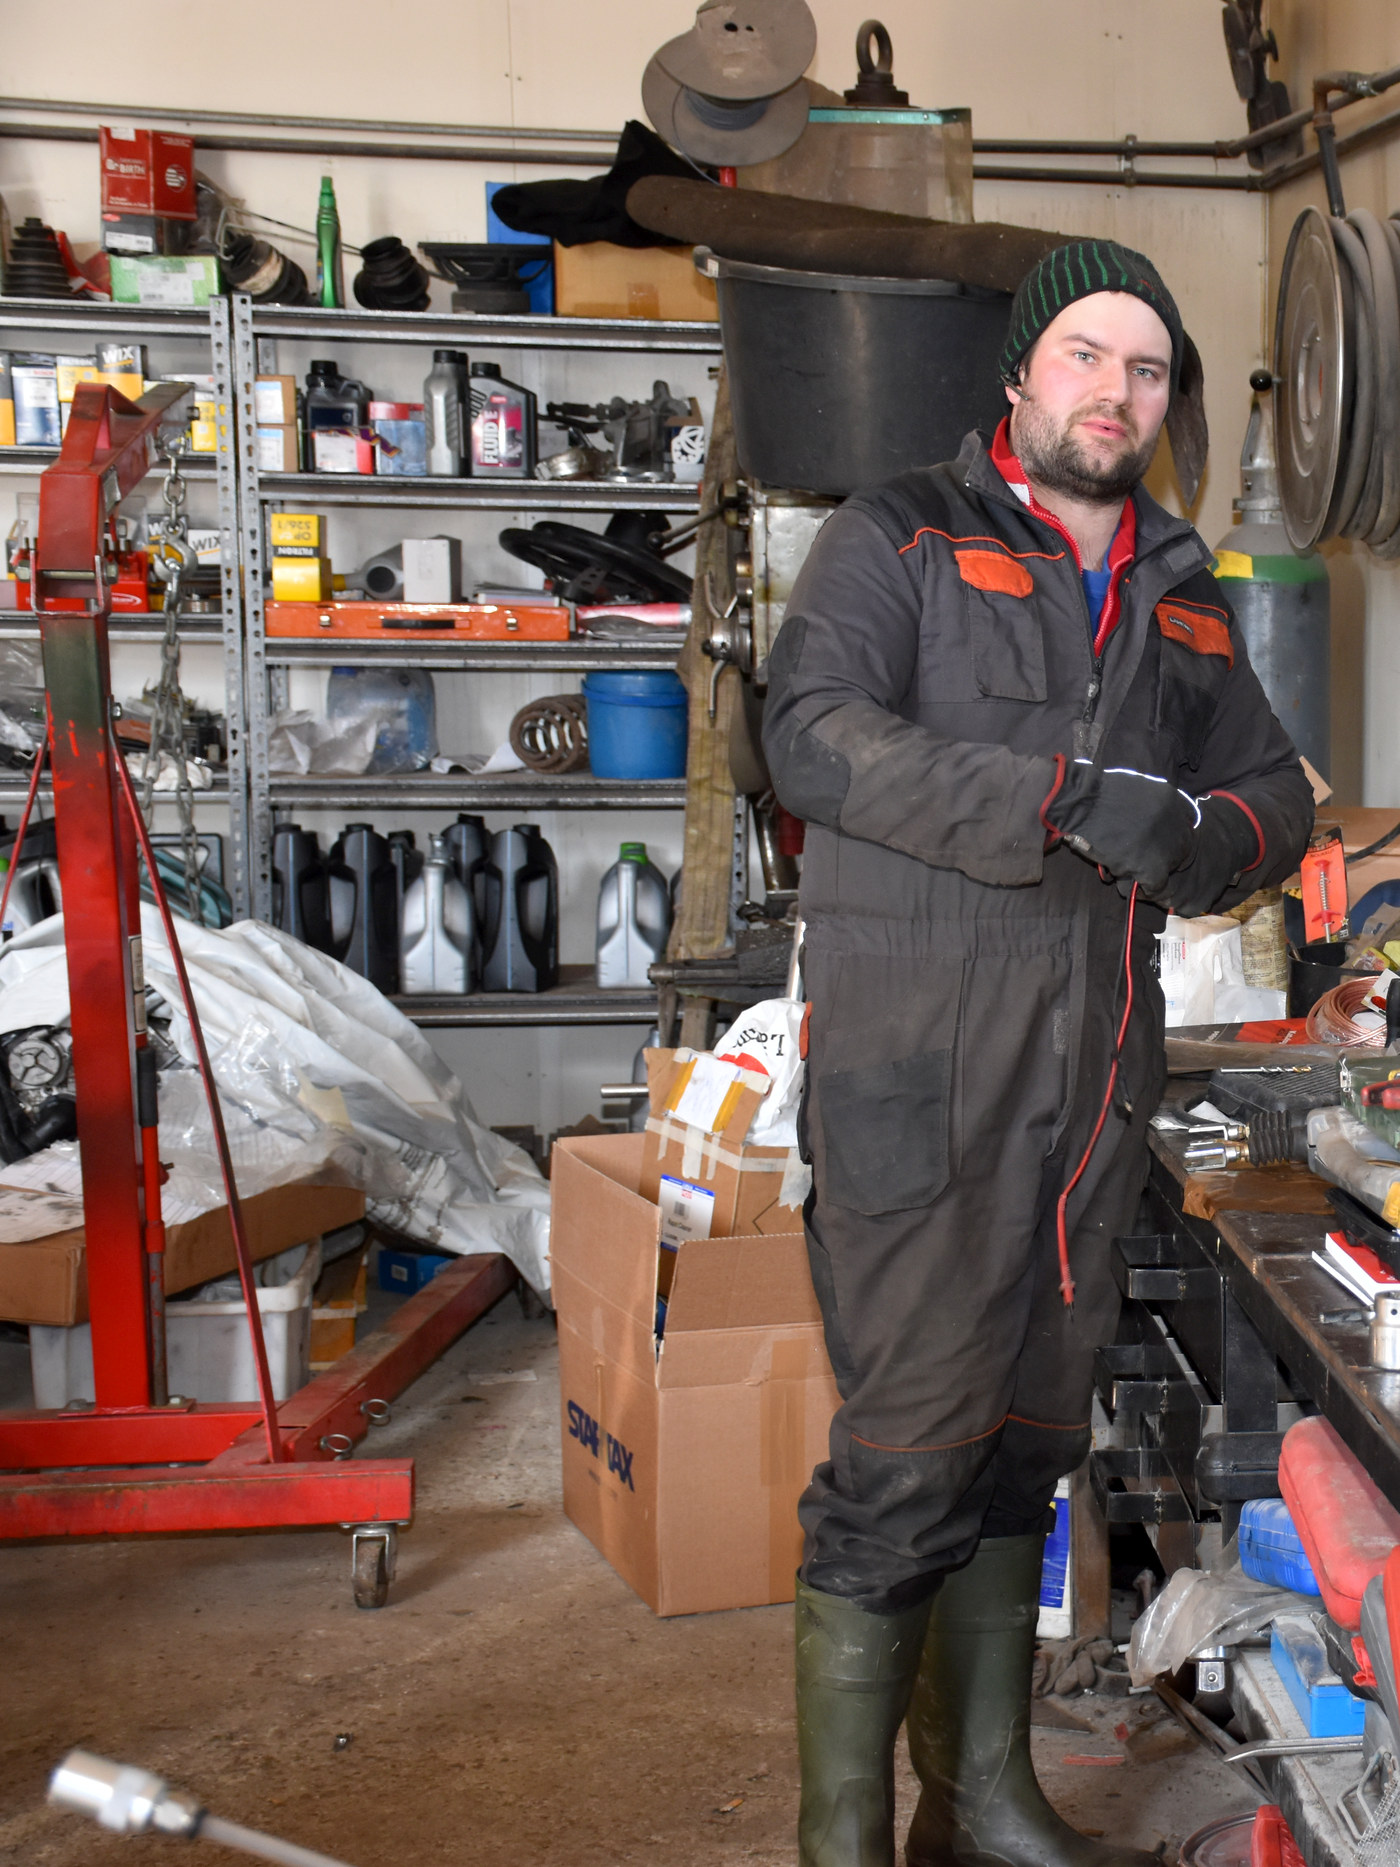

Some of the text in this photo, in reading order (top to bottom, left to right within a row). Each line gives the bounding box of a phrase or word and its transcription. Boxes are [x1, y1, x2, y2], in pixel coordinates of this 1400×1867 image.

[102, 346, 135, 364] WIX
[483, 421, 499, 463] FLUID
[192, 536, 220, 552] WIX
